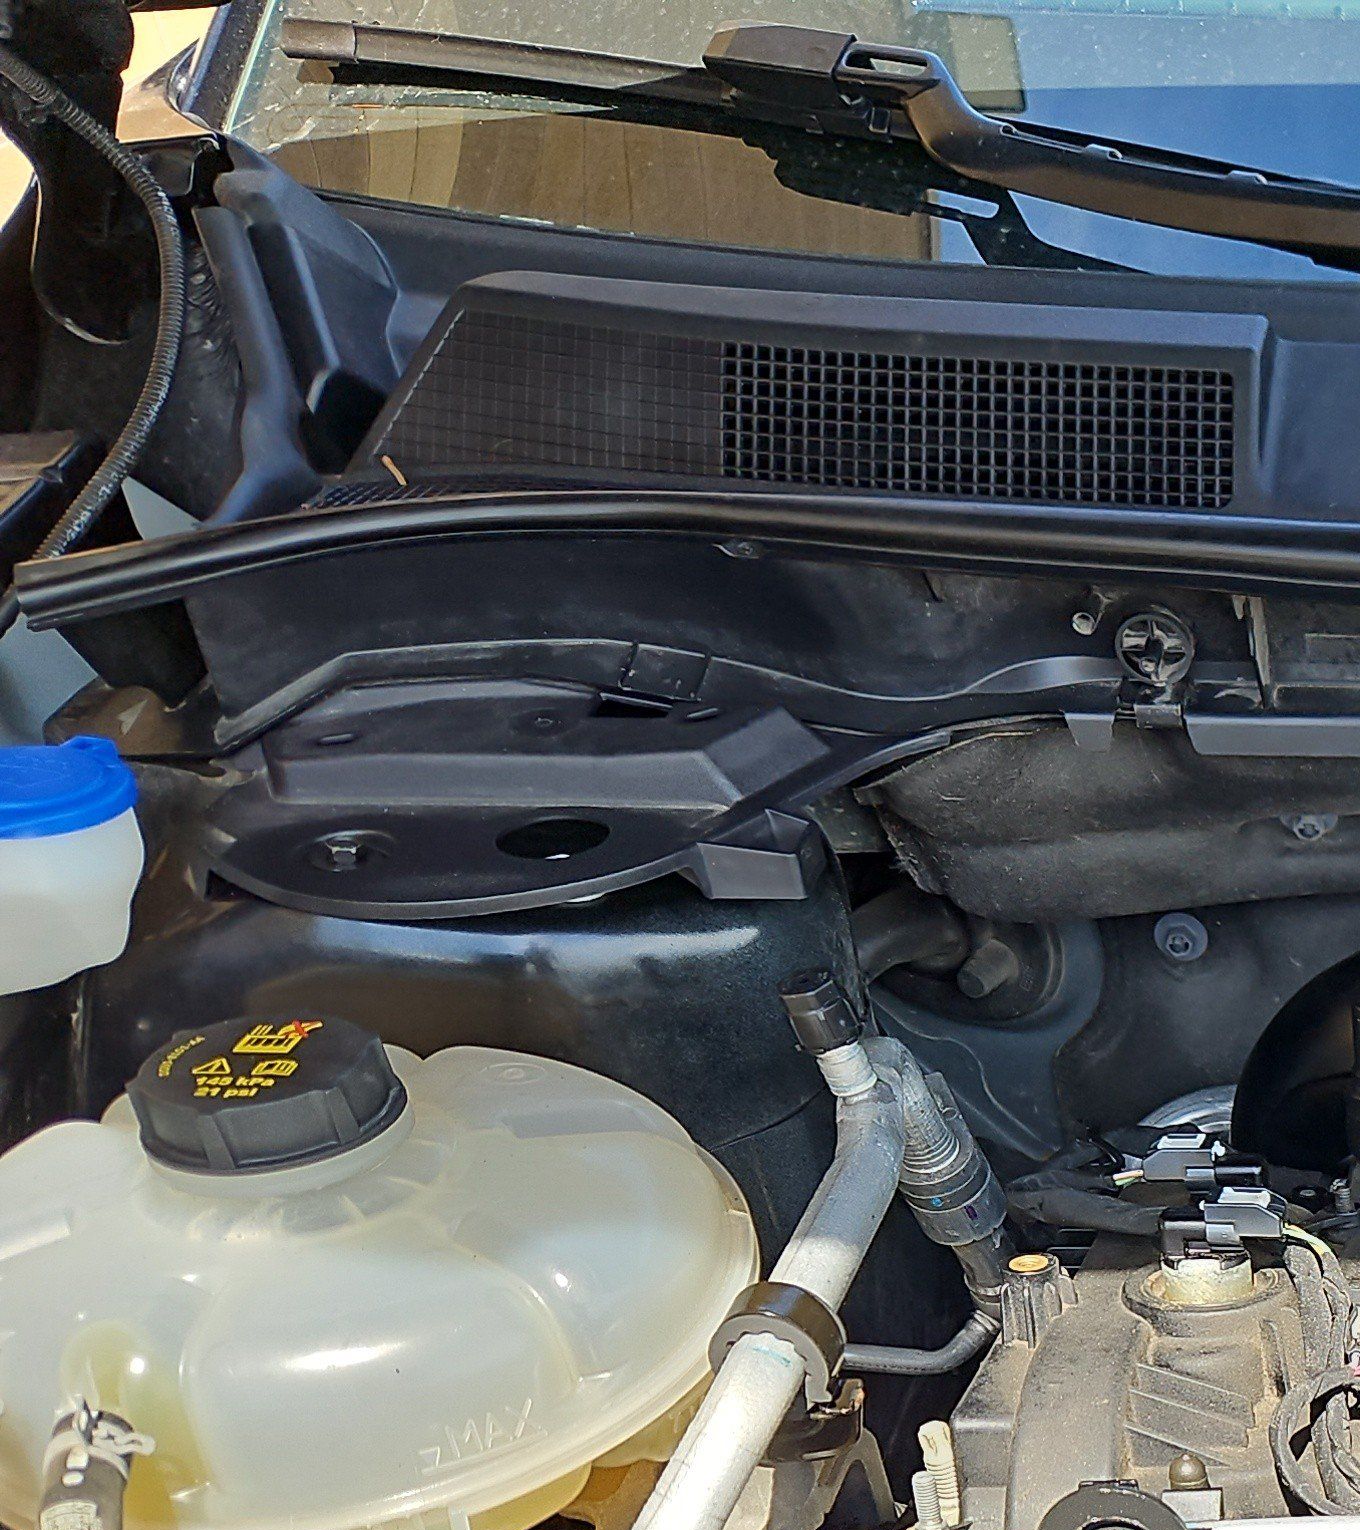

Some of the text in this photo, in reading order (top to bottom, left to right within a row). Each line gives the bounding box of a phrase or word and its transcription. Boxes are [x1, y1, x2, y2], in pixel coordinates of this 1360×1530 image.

[236, 1076, 275, 1086] kPa
[194, 1087, 259, 1098] 21 psi
